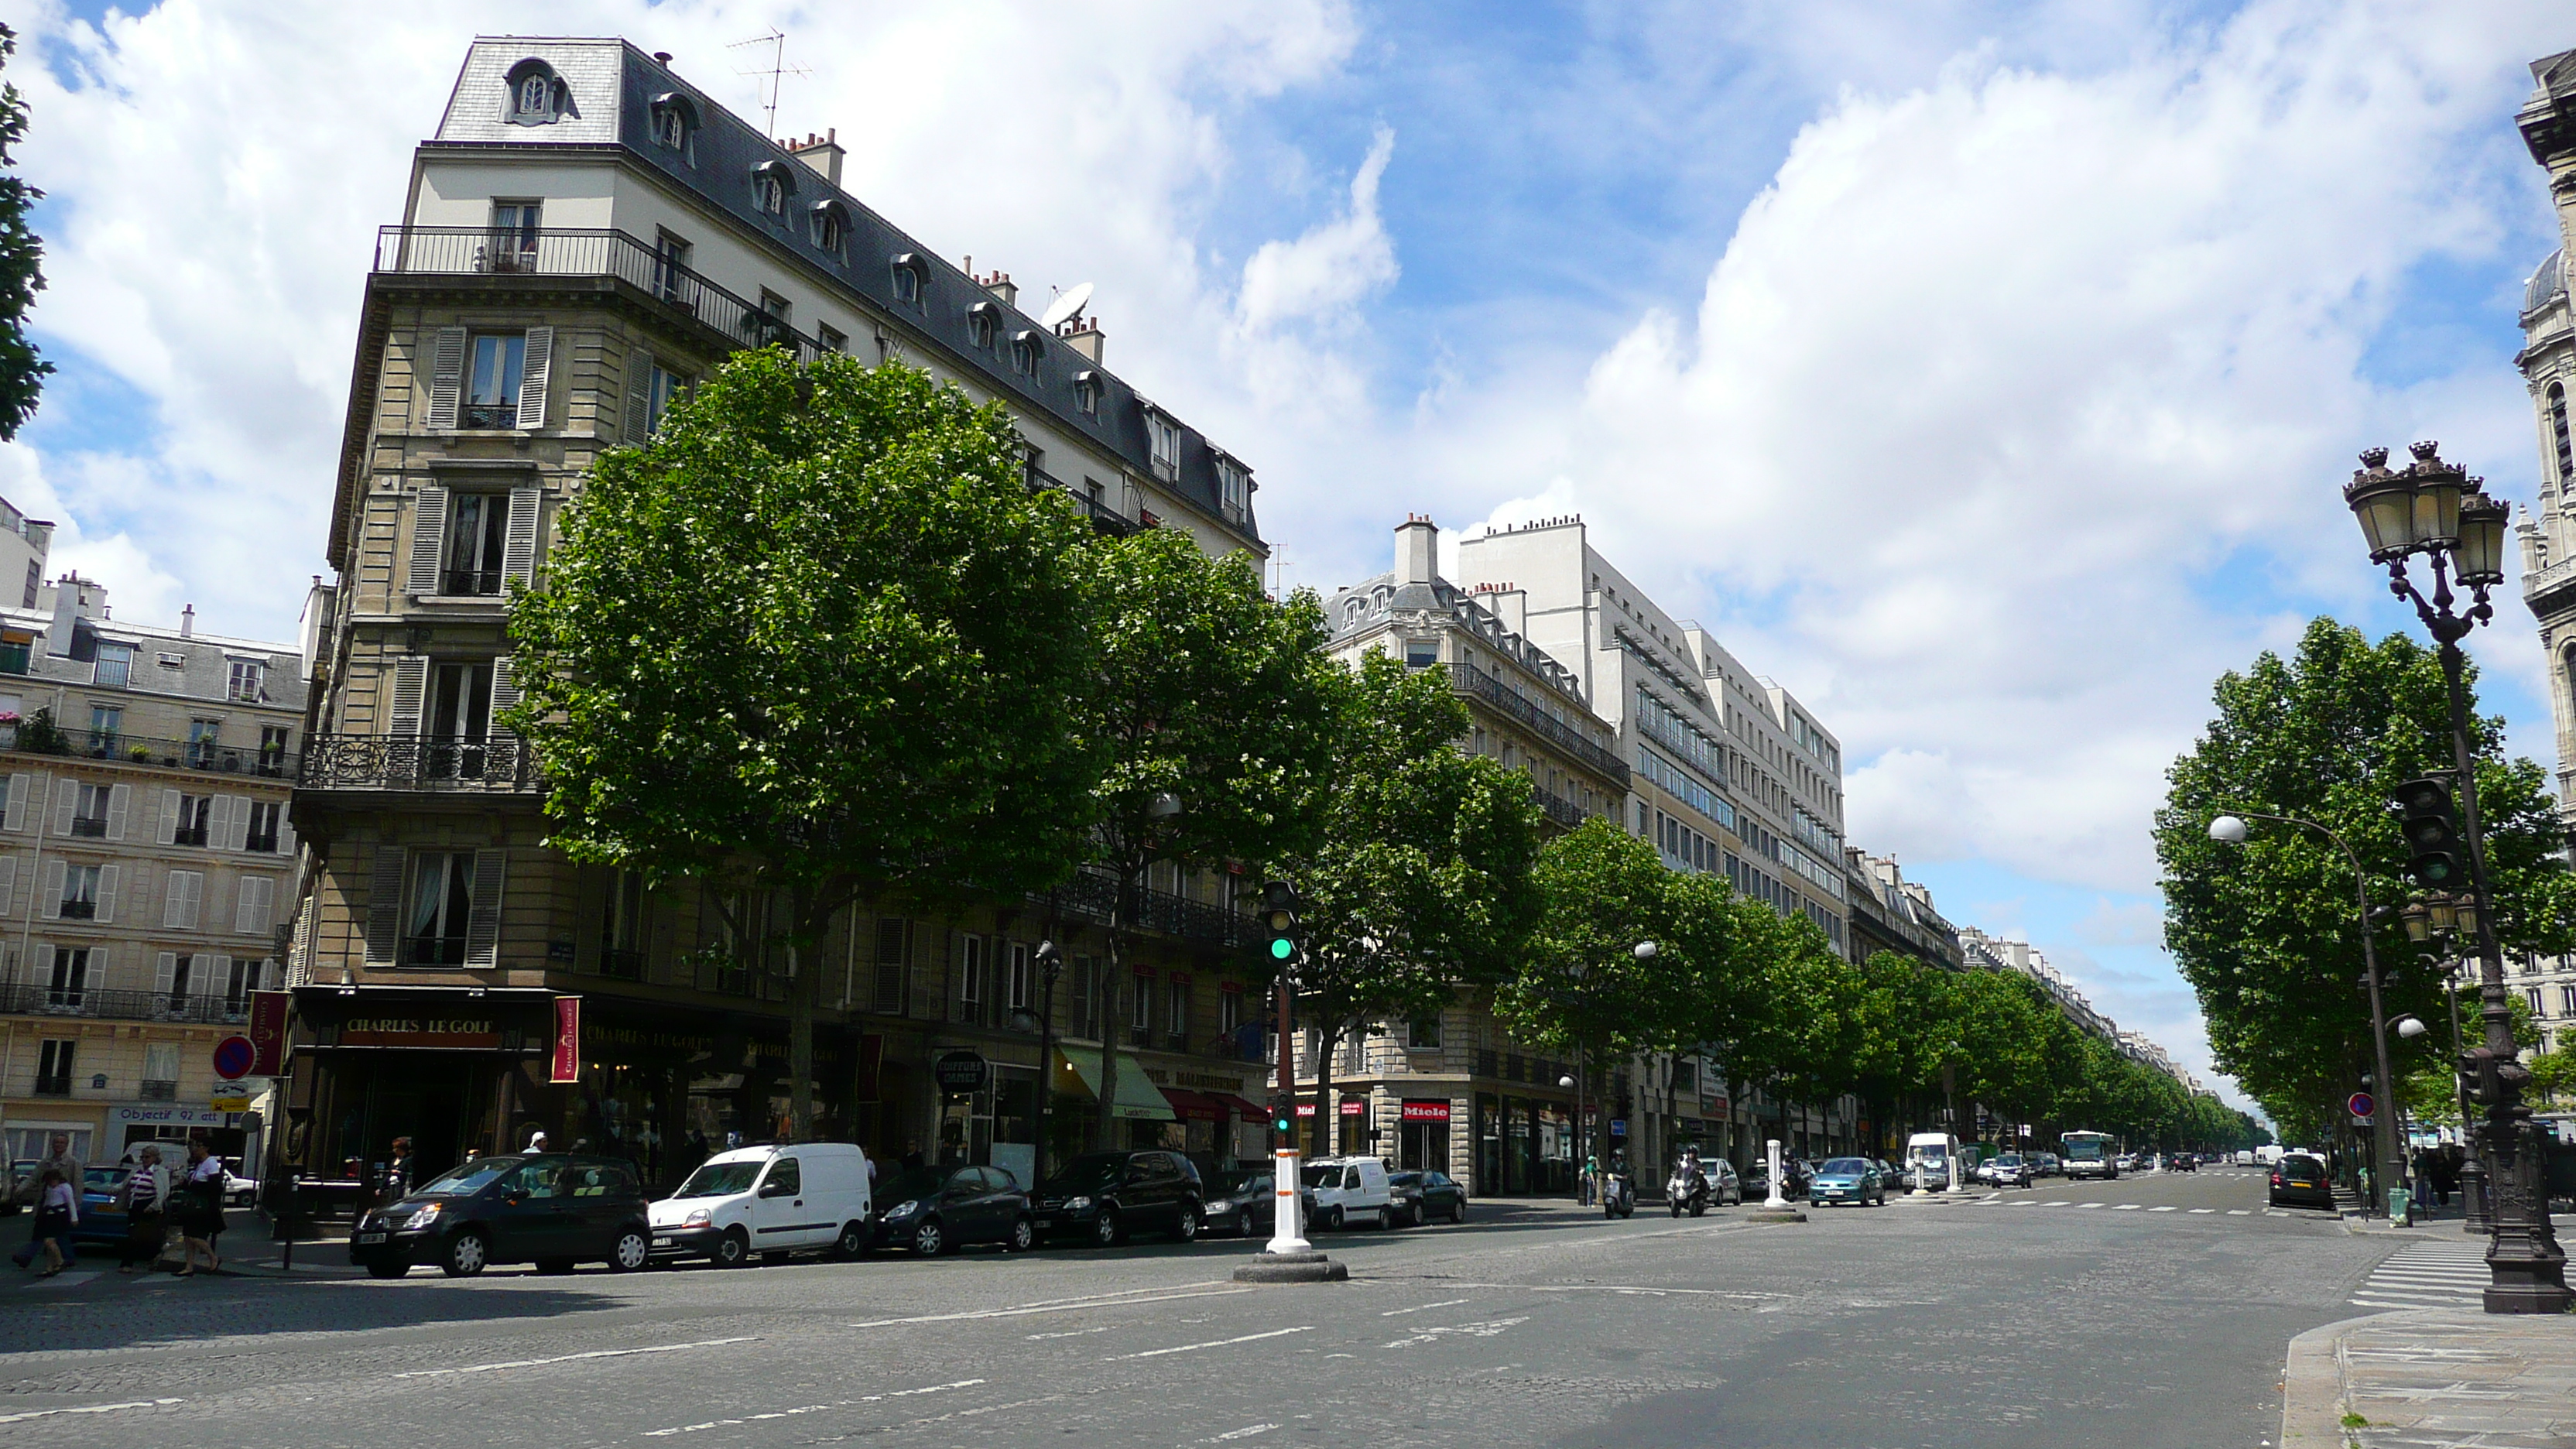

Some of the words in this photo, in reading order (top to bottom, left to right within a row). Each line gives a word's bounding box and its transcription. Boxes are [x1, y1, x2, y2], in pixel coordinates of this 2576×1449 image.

[347, 1017, 419, 1033] CHARLES
[427, 1018, 447, 1033] LE
[449, 1018, 492, 1034] GOLF
[121, 1108, 172, 1121] Objectif
[180, 1111, 194, 1121] 92
[1404, 1107, 1447, 1117] Miele
